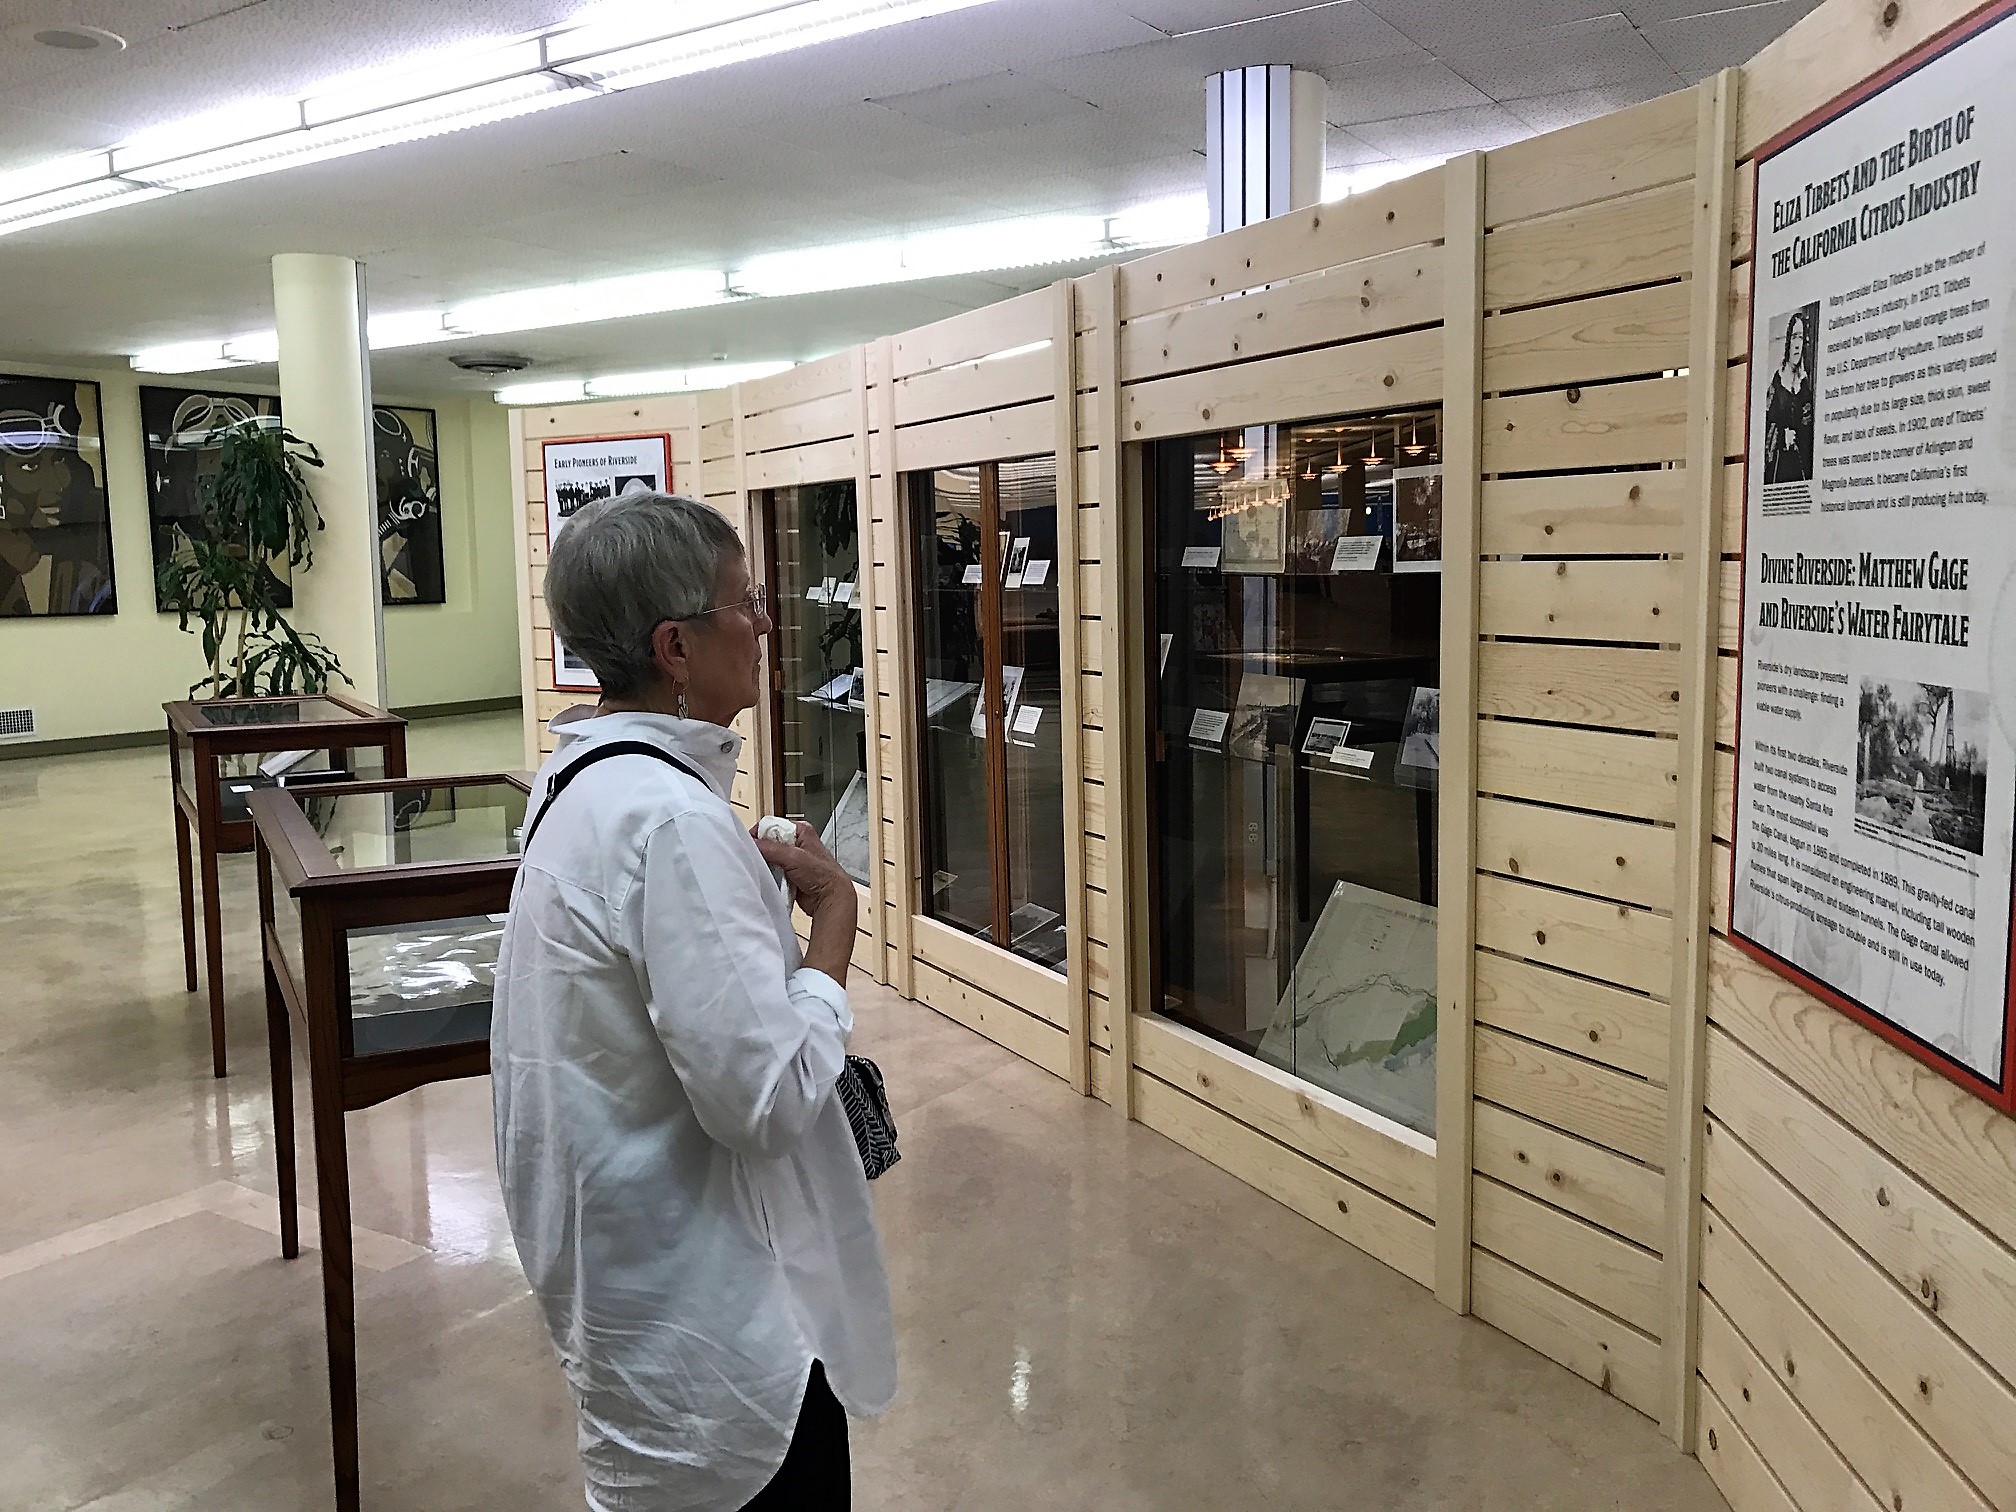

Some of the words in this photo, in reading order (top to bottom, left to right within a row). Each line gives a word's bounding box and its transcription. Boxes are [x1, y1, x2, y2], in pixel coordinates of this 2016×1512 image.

[1772, 195, 1802, 234] ELIZA
[1805, 169, 1850, 219] TIBBETS
[1851, 156, 1878, 196] AND
[1880, 140, 1906, 181] THE
[1907, 116, 1953, 169] BIRTH
[1955, 105, 1975, 145] OF
[1771, 246, 1791, 279] THE
[1792, 216, 1857, 270] CALIFORNIA
[1859, 194, 1906, 242] CITRUS
[1906, 160, 1981, 222] INDUSTRY
[554, 458, 571, 469] EARLY
[572, 456, 599, 468] PIONEERS
[600, 457, 606, 467] OF
[608, 455, 638, 466] RIVERSIDE
[1760, 552, 1795, 585] DIVINE
[1795, 552, 1856, 587] RIVERSIDE:
[1858, 552, 1926, 589] MATTHEW
[1928, 550, 1969, 591] GAGE
[1758, 602, 1779, 628] AND
[1780, 597, 1845, 636] RIVERSIDE'S
[1847, 601, 1890, 640] WATER
[1891, 604, 1970, 648] FAIRYTALE
[1872, 870, 1879, 881] in
[1901, 878, 1916, 896] This
[1916, 888, 1954, 912] gravity-fed
[1954, 903, 1976, 921] canal
[1887, 921, 1900, 938] The
[1900, 928, 1919, 948] Gage
[1919, 939, 1939, 957] canal
[1940, 948, 1970, 972] allowed
[1901, 903, 1932, 931] including
[1932, 918, 1945, 934] tall
[1945, 926, 1976, 948] wooden
[1867, 938, 1880, 953] and
[1880, 945, 1887, 956] is
[1887, 948, 1901, 963] still
[1901, 952, 1909, 967] in
[1909, 960, 1923, 974] use
